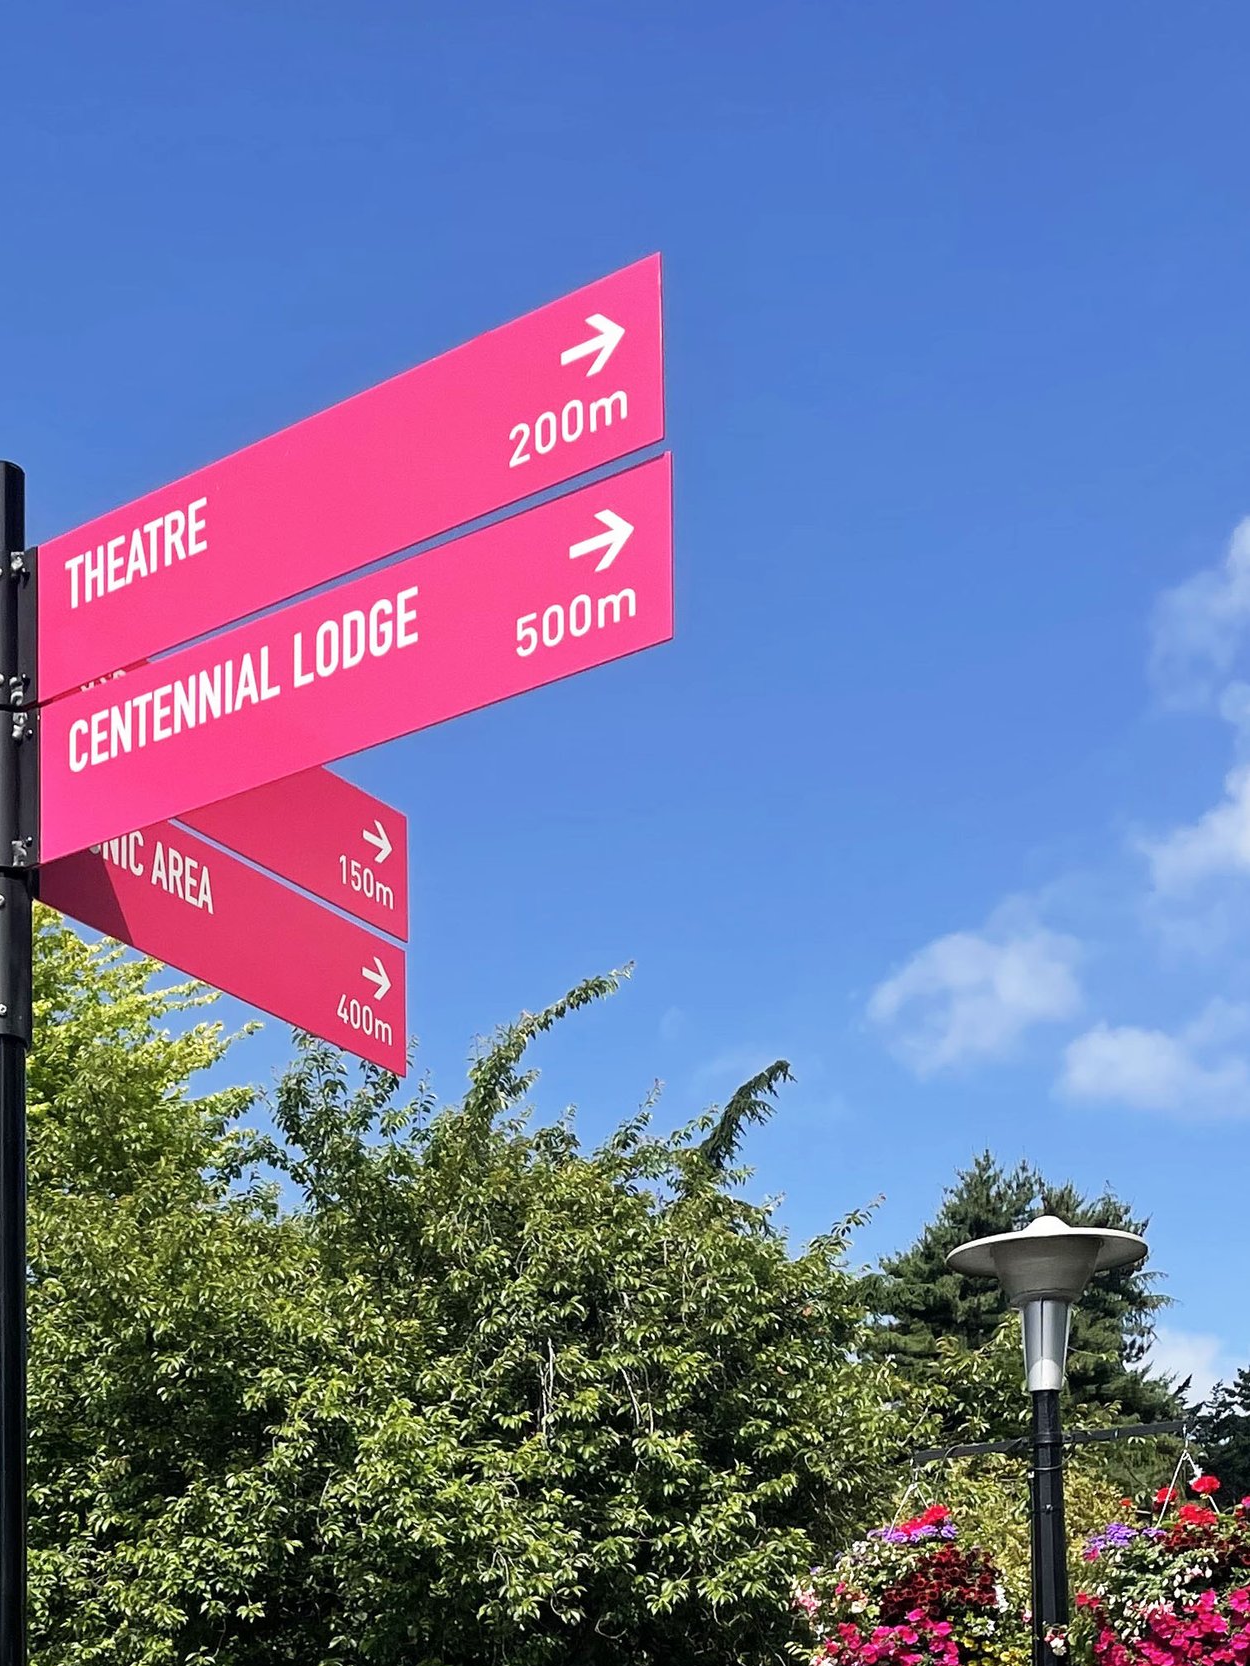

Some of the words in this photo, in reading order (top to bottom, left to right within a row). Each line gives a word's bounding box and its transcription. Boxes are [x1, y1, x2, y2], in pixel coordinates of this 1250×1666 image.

[508, 389, 629, 468] 200m
[64, 496, 209, 609] THEATRE
[515, 587, 638, 657] 500m
[68, 645, 282, 774] CENTENNIAL
[292, 585, 420, 689] LODGE
[90, 829, 144, 877] NIC
[150, 840, 214, 915] AREA
[338, 853, 395, 910] 150m
[336, 993, 393, 1046] 400m
